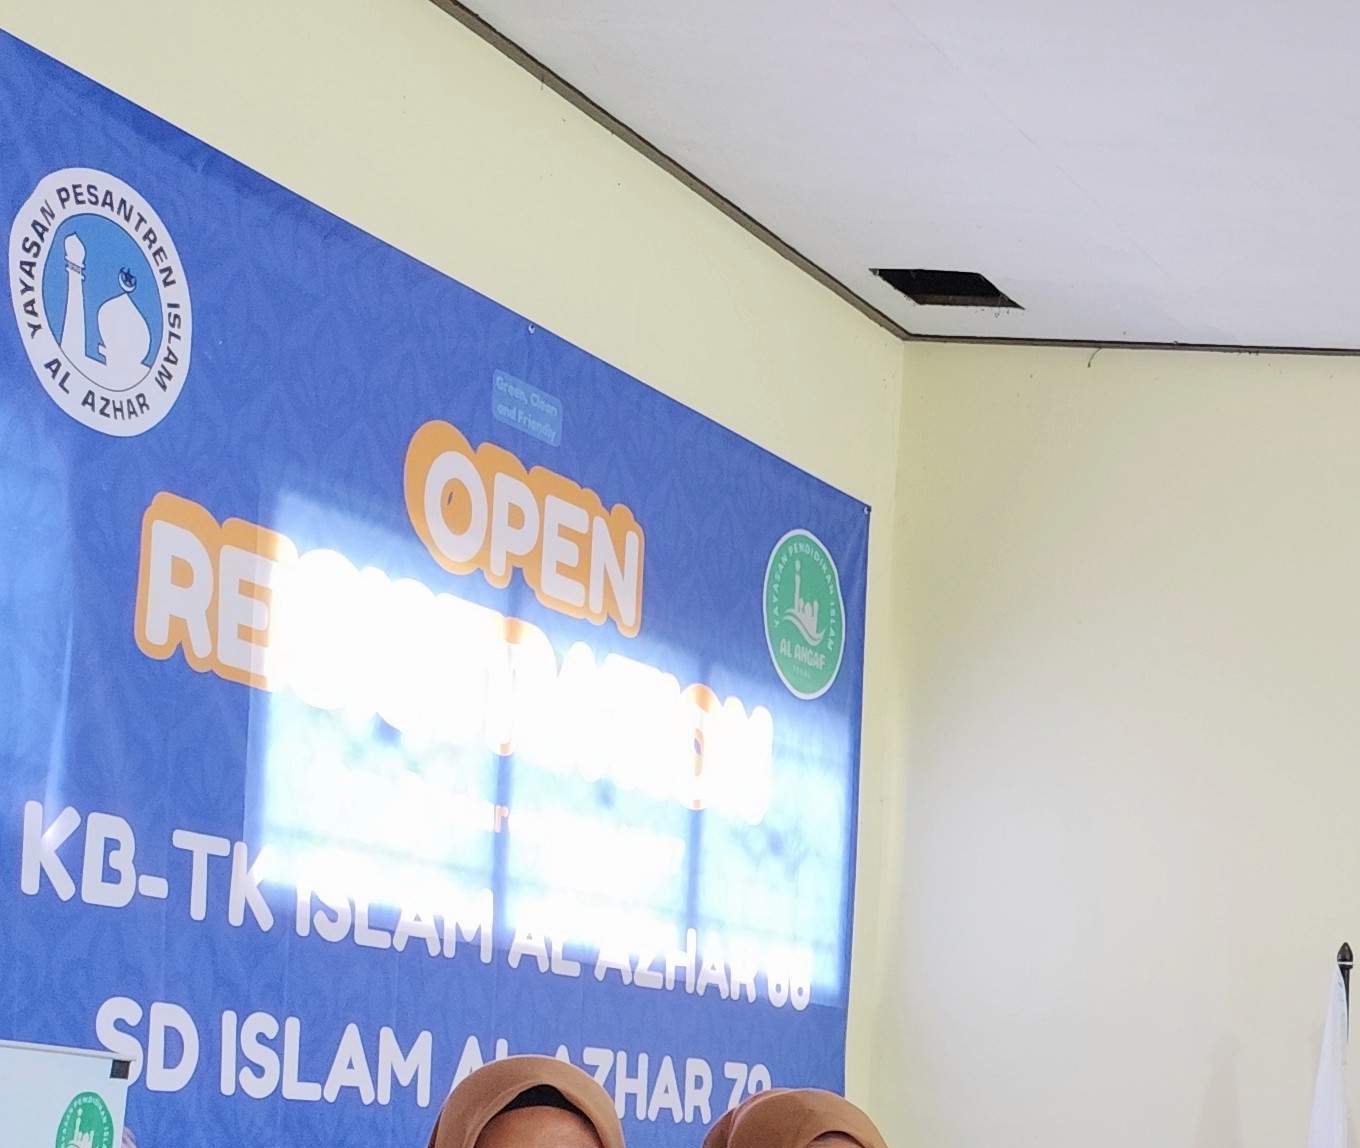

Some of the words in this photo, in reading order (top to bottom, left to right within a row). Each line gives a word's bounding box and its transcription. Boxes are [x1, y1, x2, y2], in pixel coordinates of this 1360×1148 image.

[19, 199, 56, 340] YAYASAN
[56, 184, 177, 289] PESANTREN
[155, 302, 182, 393] ISLAM
[44, 357, 71, 394] AL
[81, 389, 151, 421] AZHAR
[422, 449, 641, 629] OPEN
[773, 555, 788, 628] YAYASAN
[788, 542, 834, 595] PENDIDIKAN
[780, 638, 792, 658] AL
[20, 799, 274, 933] KB-TK
[95, 996, 200, 1094] SD
[220, 1008, 433, 1106] ISLAM
[555, 1044, 713, 1124] ZHAR
